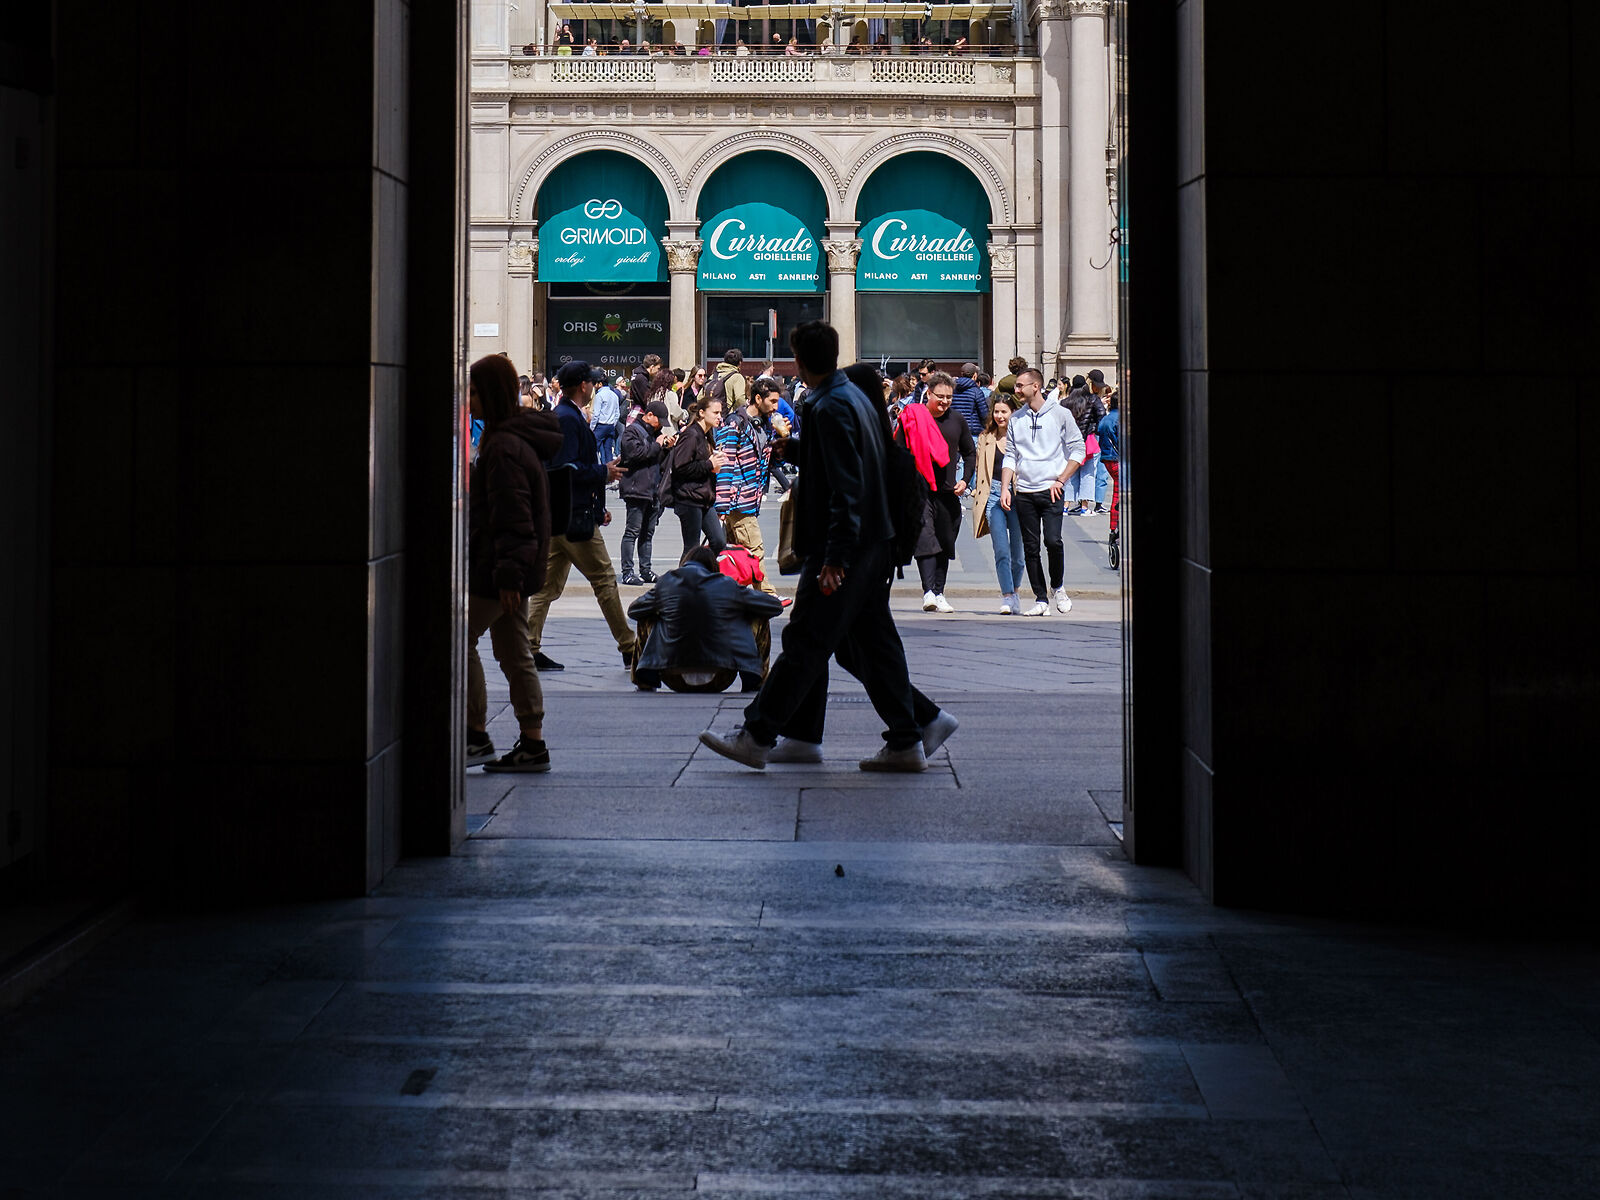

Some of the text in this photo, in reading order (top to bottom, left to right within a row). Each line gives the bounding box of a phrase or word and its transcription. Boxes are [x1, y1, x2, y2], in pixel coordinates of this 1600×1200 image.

[560, 227, 647, 245] GRIMOLDI
[709, 218, 813, 260] Currado
[871, 218, 976, 260] Currado
[753, 253, 812, 261] GIOIELLERIE
[915, 253, 974, 261] GIOIELLERIE
[702, 272, 737, 280] MILANO
[778, 273, 820, 281] SANREMO
[864, 272, 899, 280] MILANO
[940, 273, 982, 281] SANREMO
[563, 321, 598, 332] ORIS
[600, 355, 642, 363] GRIMOL
